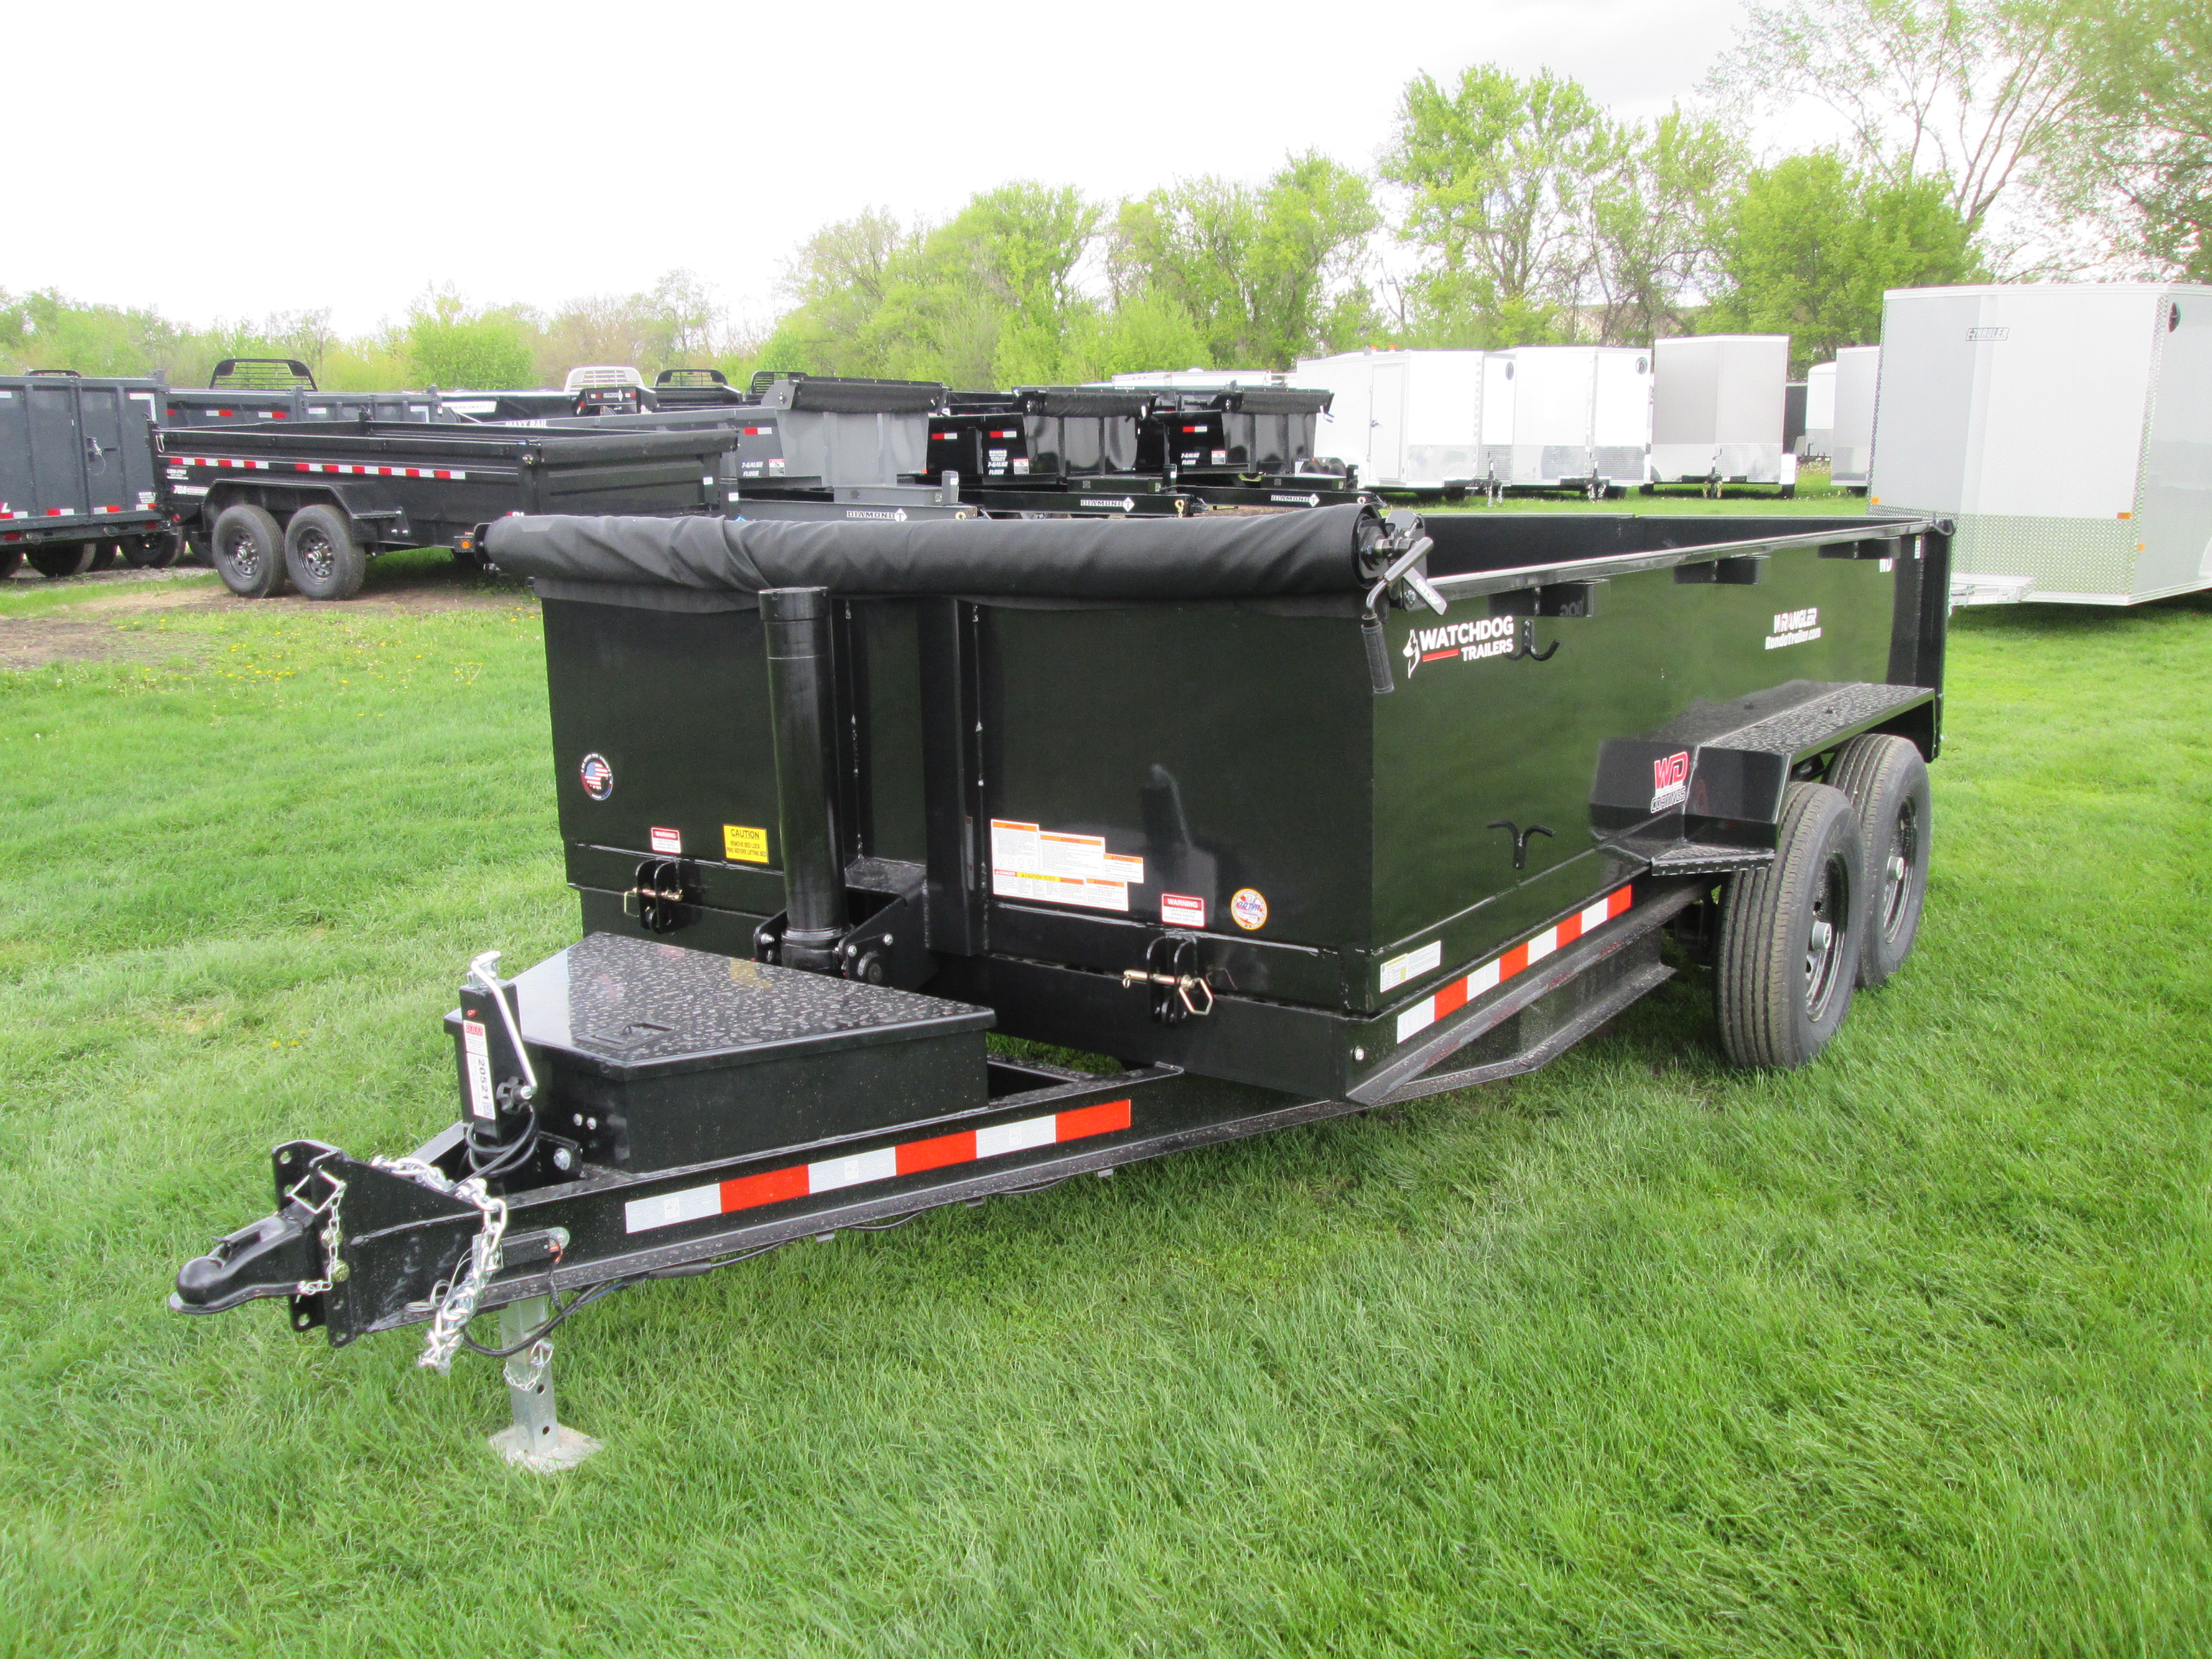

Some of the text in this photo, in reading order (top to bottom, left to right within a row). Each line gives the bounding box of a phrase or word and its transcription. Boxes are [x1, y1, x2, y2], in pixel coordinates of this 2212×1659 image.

[529, 419, 548, 428] RAIL
[1271, 495, 1309, 503] DIAMOND
[847, 510, 895, 520] DIAMOND
[1774, 607, 1818, 634] WRANGLER
[1419, 615, 1515, 651] WATCHDOG
[1460, 638, 1514, 662] TRAILERS
[1654, 752, 1688, 790] WD
[655, 831, 676, 839] WARNING
[731, 828, 760, 840] CAUTION
[1167, 898, 1199, 908] WARNING
[466, 1025, 483, 1037] RAM
[478, 1059, 489, 1099] 20521
